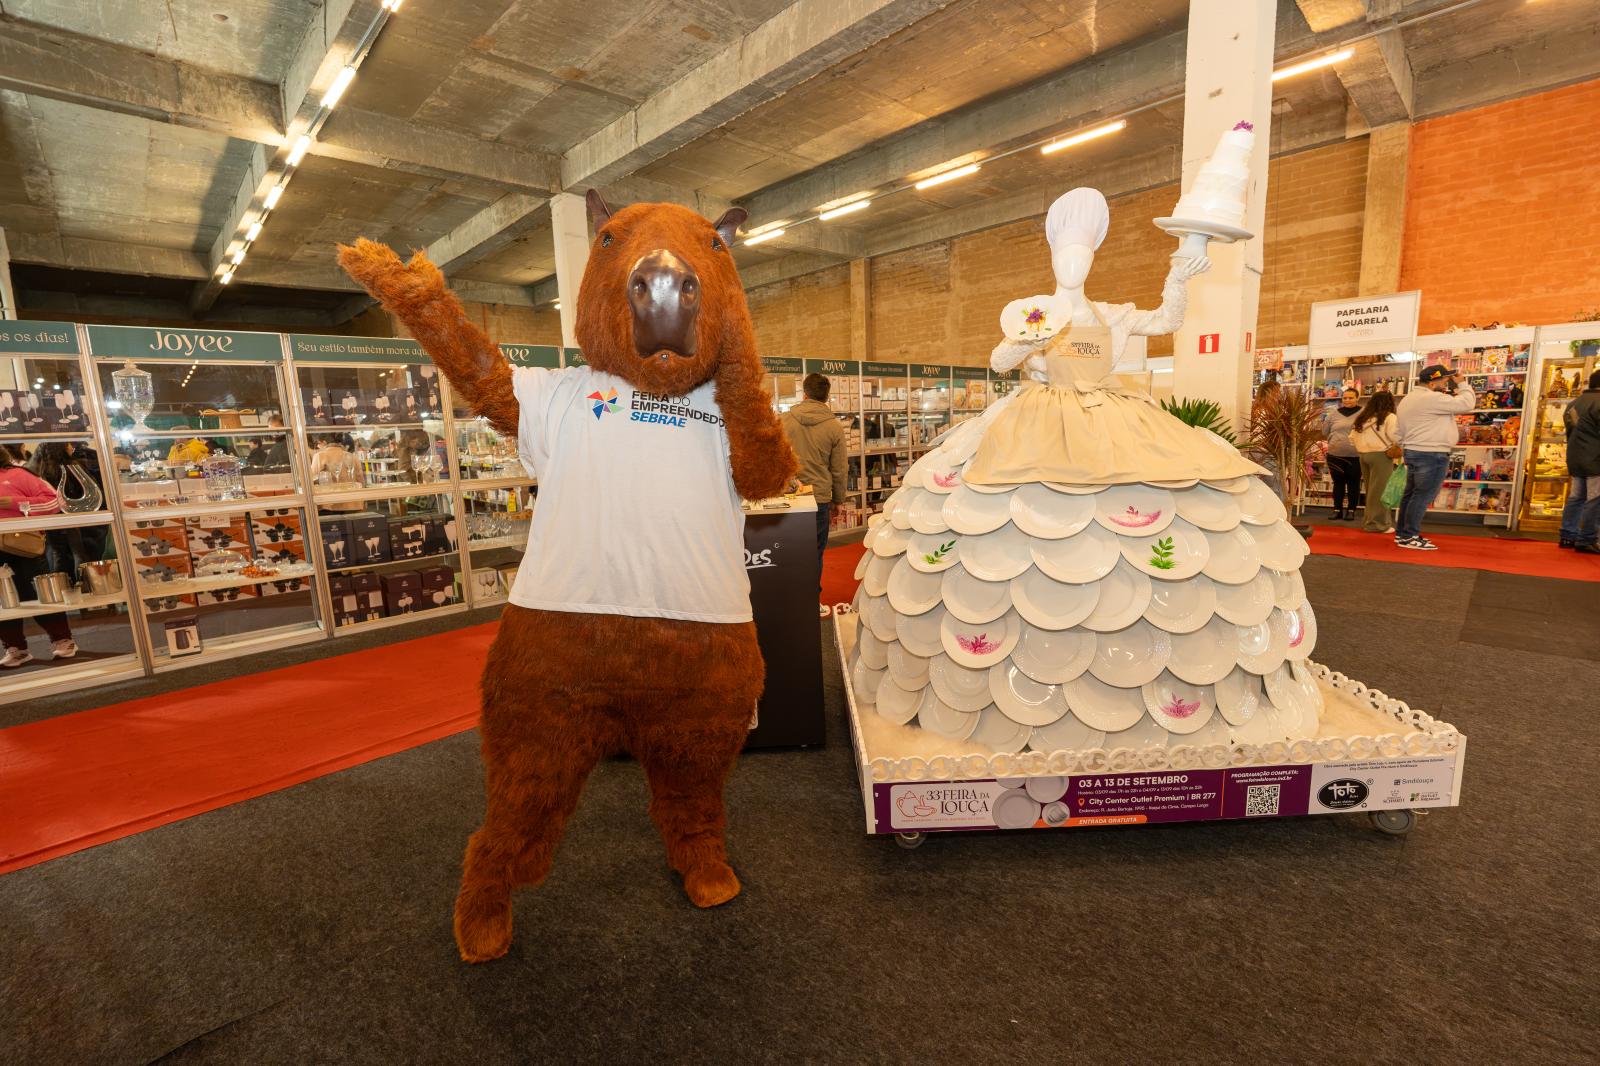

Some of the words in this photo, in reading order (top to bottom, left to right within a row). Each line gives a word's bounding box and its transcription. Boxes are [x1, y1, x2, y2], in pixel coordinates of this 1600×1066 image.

[1336, 305, 1390, 317] PAPELARIA
[1335, 316, 1388, 328] AQUARELA
[14, 333, 32, 342] os
[35, 331, 70, 343] dias!
[297, 341, 317, 352] Seu
[319, 342, 346, 353] estilo
[347, 343, 384, 355] também
[386, 346, 410, 355] mora
[632, 390, 670, 404] FEIRA
[672, 396, 691, 407] DO
[630, 411, 688, 428] SEBRAE
[631, 400, 728, 429] EMPREENDEDO
[1231, 770, 1270, 778] PROGRAMAÇÃO
[1078, 780, 1092, 788] 03
[1104, 778, 1115, 787] 13
[1116, 778, 1131, 786] DE
[1132, 776, 1188, 786] SETEMBRO
[943, 789, 978, 800] FEIRA
[940, 800, 990, 815] LOUÇA
